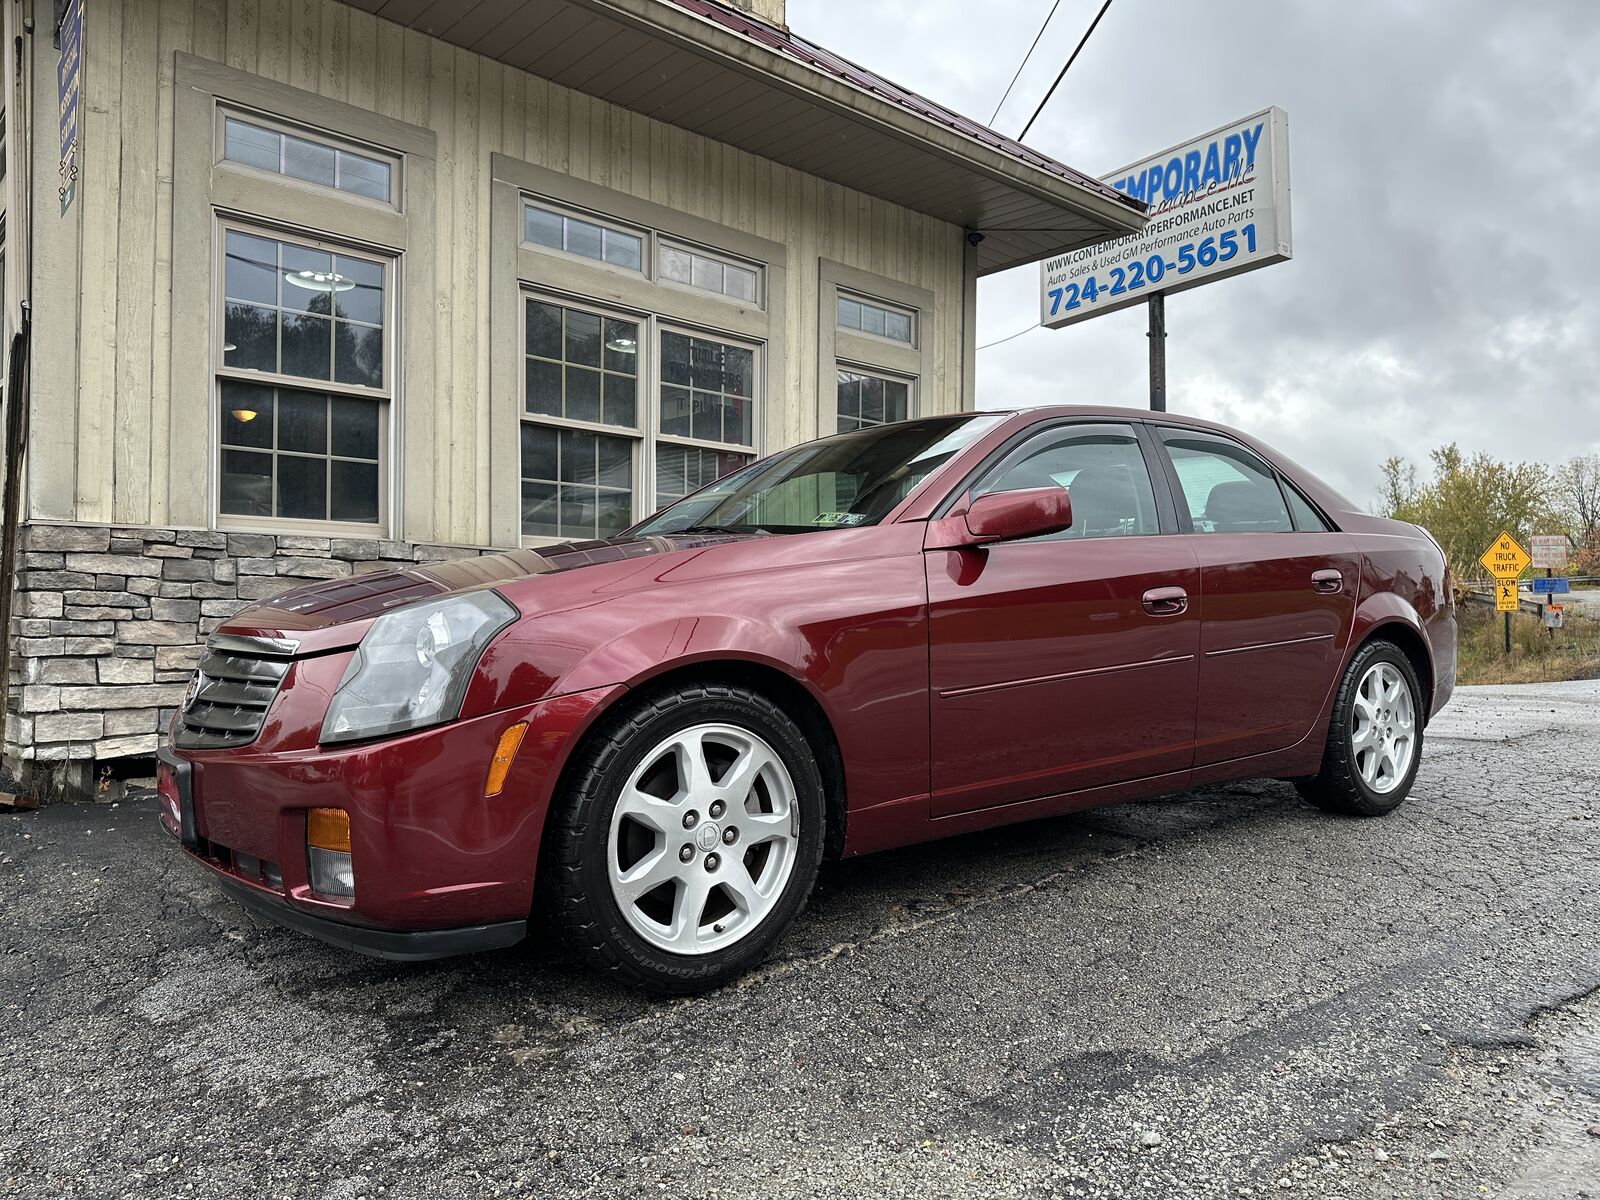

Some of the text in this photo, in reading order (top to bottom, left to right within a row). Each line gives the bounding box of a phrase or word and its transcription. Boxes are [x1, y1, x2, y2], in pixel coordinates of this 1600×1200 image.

[1047, 208, 1255, 286] Auto Sales & Used GM Performance Auto Parts
[1047, 223, 1257, 317] 724-220-5651
[1500, 541, 1510, 550] NO
[1495, 552, 1516, 561] TRUCK
[1493, 563, 1519, 572] TRAFFIC
